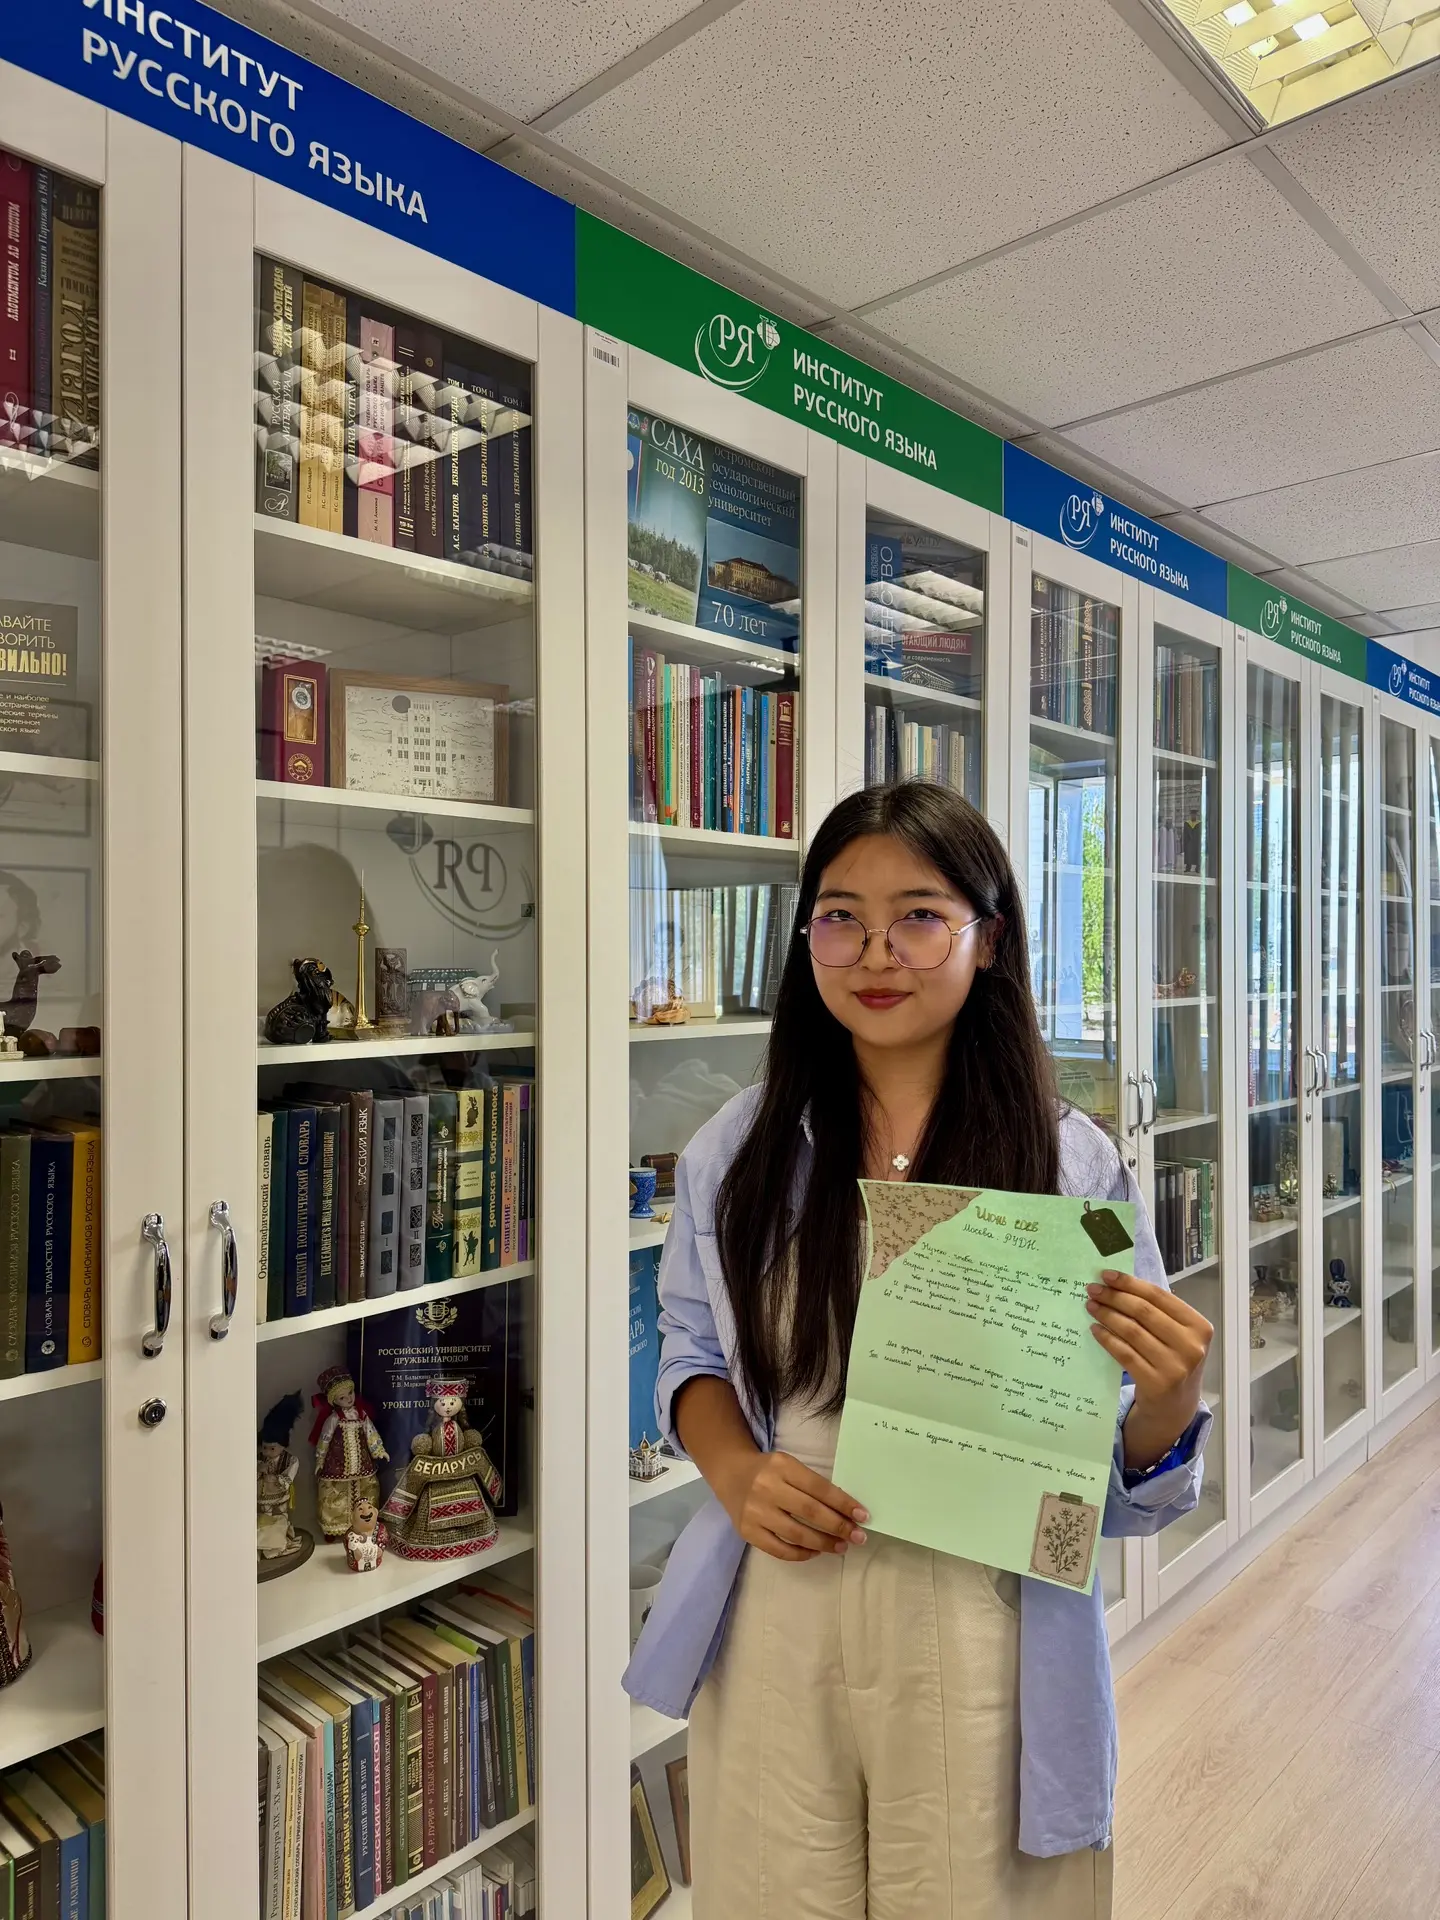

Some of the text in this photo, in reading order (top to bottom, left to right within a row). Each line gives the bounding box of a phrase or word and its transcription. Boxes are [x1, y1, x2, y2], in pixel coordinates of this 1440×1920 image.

[83, 28, 428, 223] РУССКОГО ЯЗЫКА
[38, 205, 51, 245] Париже
[8, 200, 20, 322] ARGUMENTUM AD JUDICIUM
[37, 252, 49, 288] Казаки
[273, 266, 284, 358] ЭНЦИКЛОПЕДИЯ
[283, 284, 294, 348] ДЛЯ ДЕТЕЙ
[793, 348, 884, 411] ИНСТИТУТ
[271, 379, 282, 425] РУССКАЯ
[282, 378, 292, 442] ЛИТЕРАТУРА
[347, 380, 357, 464] ЛИКИ УСПЕХА
[450, 395, 459, 428] ТРУДЫ
[480, 398, 489, 429] ТРУДЫ
[651, 418, 705, 472] САХА
[793, 383, 938, 470] РУССКОГО ЯЗЫКА
[451, 431, 459, 487] ИЗБРАННЫЕ
[480, 431, 489, 487] ИЗБРАННЫЕ
[513, 441, 521, 495] ИЗБРАННЫЕ
[655, 457, 705, 497] год 2013
[713, 446, 776, 479] остромской
[452, 493, 460, 531] КАРПОВ.
[481, 493, 490, 537] НОВИКОВ.
[708, 496, 773, 527] университет
[709, 477, 796, 520] ехнологический
[513, 501, 522, 545] НОВИКОВ.
[1110, 513, 1160, 552] ИНСТИТУТ
[1110, 538, 1190, 591] РУССКОГО ЯЗЫКА
[711, 600, 769, 641] 70 лет
[1291, 610, 1322, 636] ИНСТИТУТ
[939, 637, 968, 651] ЛЮДЯМ
[1291, 630, 1342, 664] РУССКОГО ЯЗЫКА
[357, 1107, 368, 1185] РУССКИЙ ЯЗЫК
[489, 1085, 499, 1165] библиотека
[257, 1136, 271, 1280] Орфографический словарь
[296, 1120, 310, 1297] КРАТКИЙ ПОЛИТИЧЕСКИЙ СЛОВАРЬ
[320, 1131, 335, 1276] THE LEARNER'S ENGLISH-RUSSIAN DICTIONARY
[489, 1170, 497, 1228] детская
[975, 1205, 1007, 1226] Июнь
[44, 1161, 56, 1336] СЛОВАРЬ ТРУДНОСТЕЙ РУССКОГО ЯЗЫКА
[83, 1140, 96, 1329] СЛОВАРЬ СИНОНИМОВ РУССКОГО ЯЗЫКА
[378, 1344, 492, 1357] РОССИЙСКИЙ УНИВЕРСИТЕТ
[393, 1354, 469, 1366] ДРУЖБЫ НАРОДОВ
[382, 1400, 411, 1411] УРОКИ
[413, 1450, 483, 1476] БЕЛАРУСЬ
[513, 1664, 525, 1748] РУССКИЙ ЯЗЫК
[427, 1711, 435, 1760] СОЗНАНИЕ
[342, 1752, 350, 1809] КУЛЬТУРА
[359, 1758, 368, 1782] МИРЕ
[373, 1730, 381, 1796] ГЛАГОЛ
[427, 1767, 436, 1795] ЯЗЫК
[273, 1792, 281, 1806] XX
[343, 1811, 351, 1820] И
[360, 1791, 368, 1815] ЯЗЫК
[343, 1821, 352, 1852] ЯЗЫК
[360, 1815, 369, 1857] РУССКИЙ
[427, 1807, 435, 1836] ЛУРИЯ
[271, 1831, 282, 1880] литература
[344, 1854, 352, 1904] РУССКИЙ
